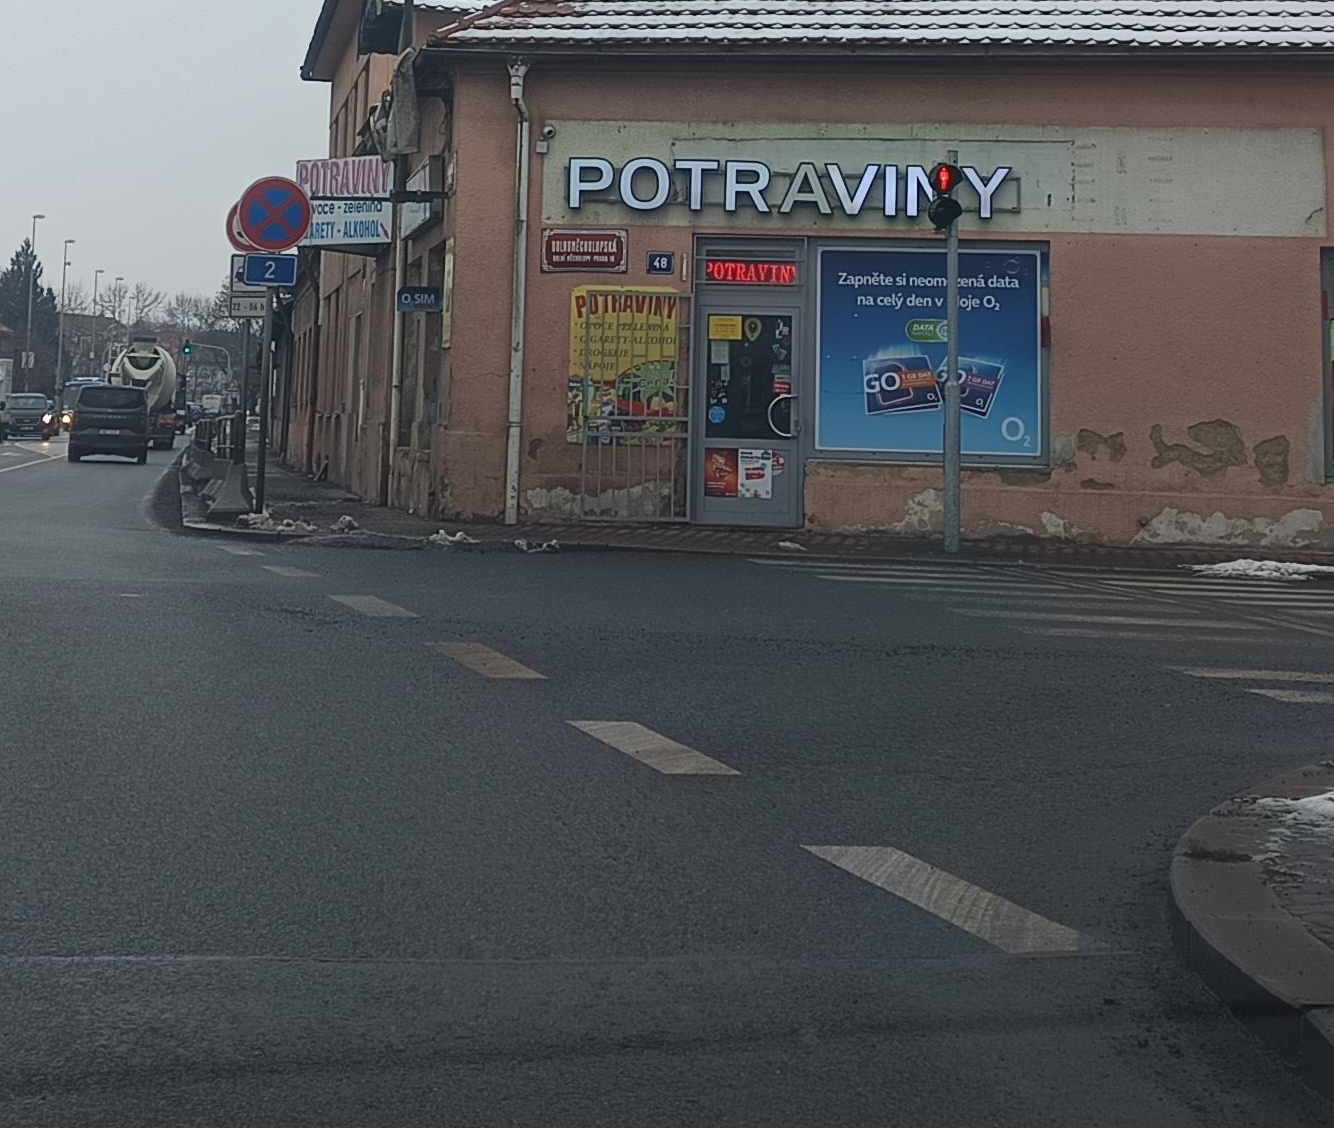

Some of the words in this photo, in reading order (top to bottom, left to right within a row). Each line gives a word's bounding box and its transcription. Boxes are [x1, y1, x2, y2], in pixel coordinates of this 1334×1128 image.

[298, 160, 392, 196] POTRAVINY
[567, 156, 1013, 219] POTRAVINY
[311, 202, 335, 214] voce
[343, 220, 381, 239] ALKOHOL
[264, 261, 275, 279] 2
[653, 257, 668, 269] 48
[838, 272, 894, 288] Zapněte
[896, 273, 907, 286] si
[909, 274, 986, 288] neomzená
[988, 274, 1020, 288] data
[414, 293, 435, 304] SIM
[857, 296, 874, 306] na
[876, 294, 903, 309] celý
[906, 295, 932, 307] den
[935, 297, 944, 307] v
[913, 324, 934, 332] DATA
[864, 372, 901, 393] GO
